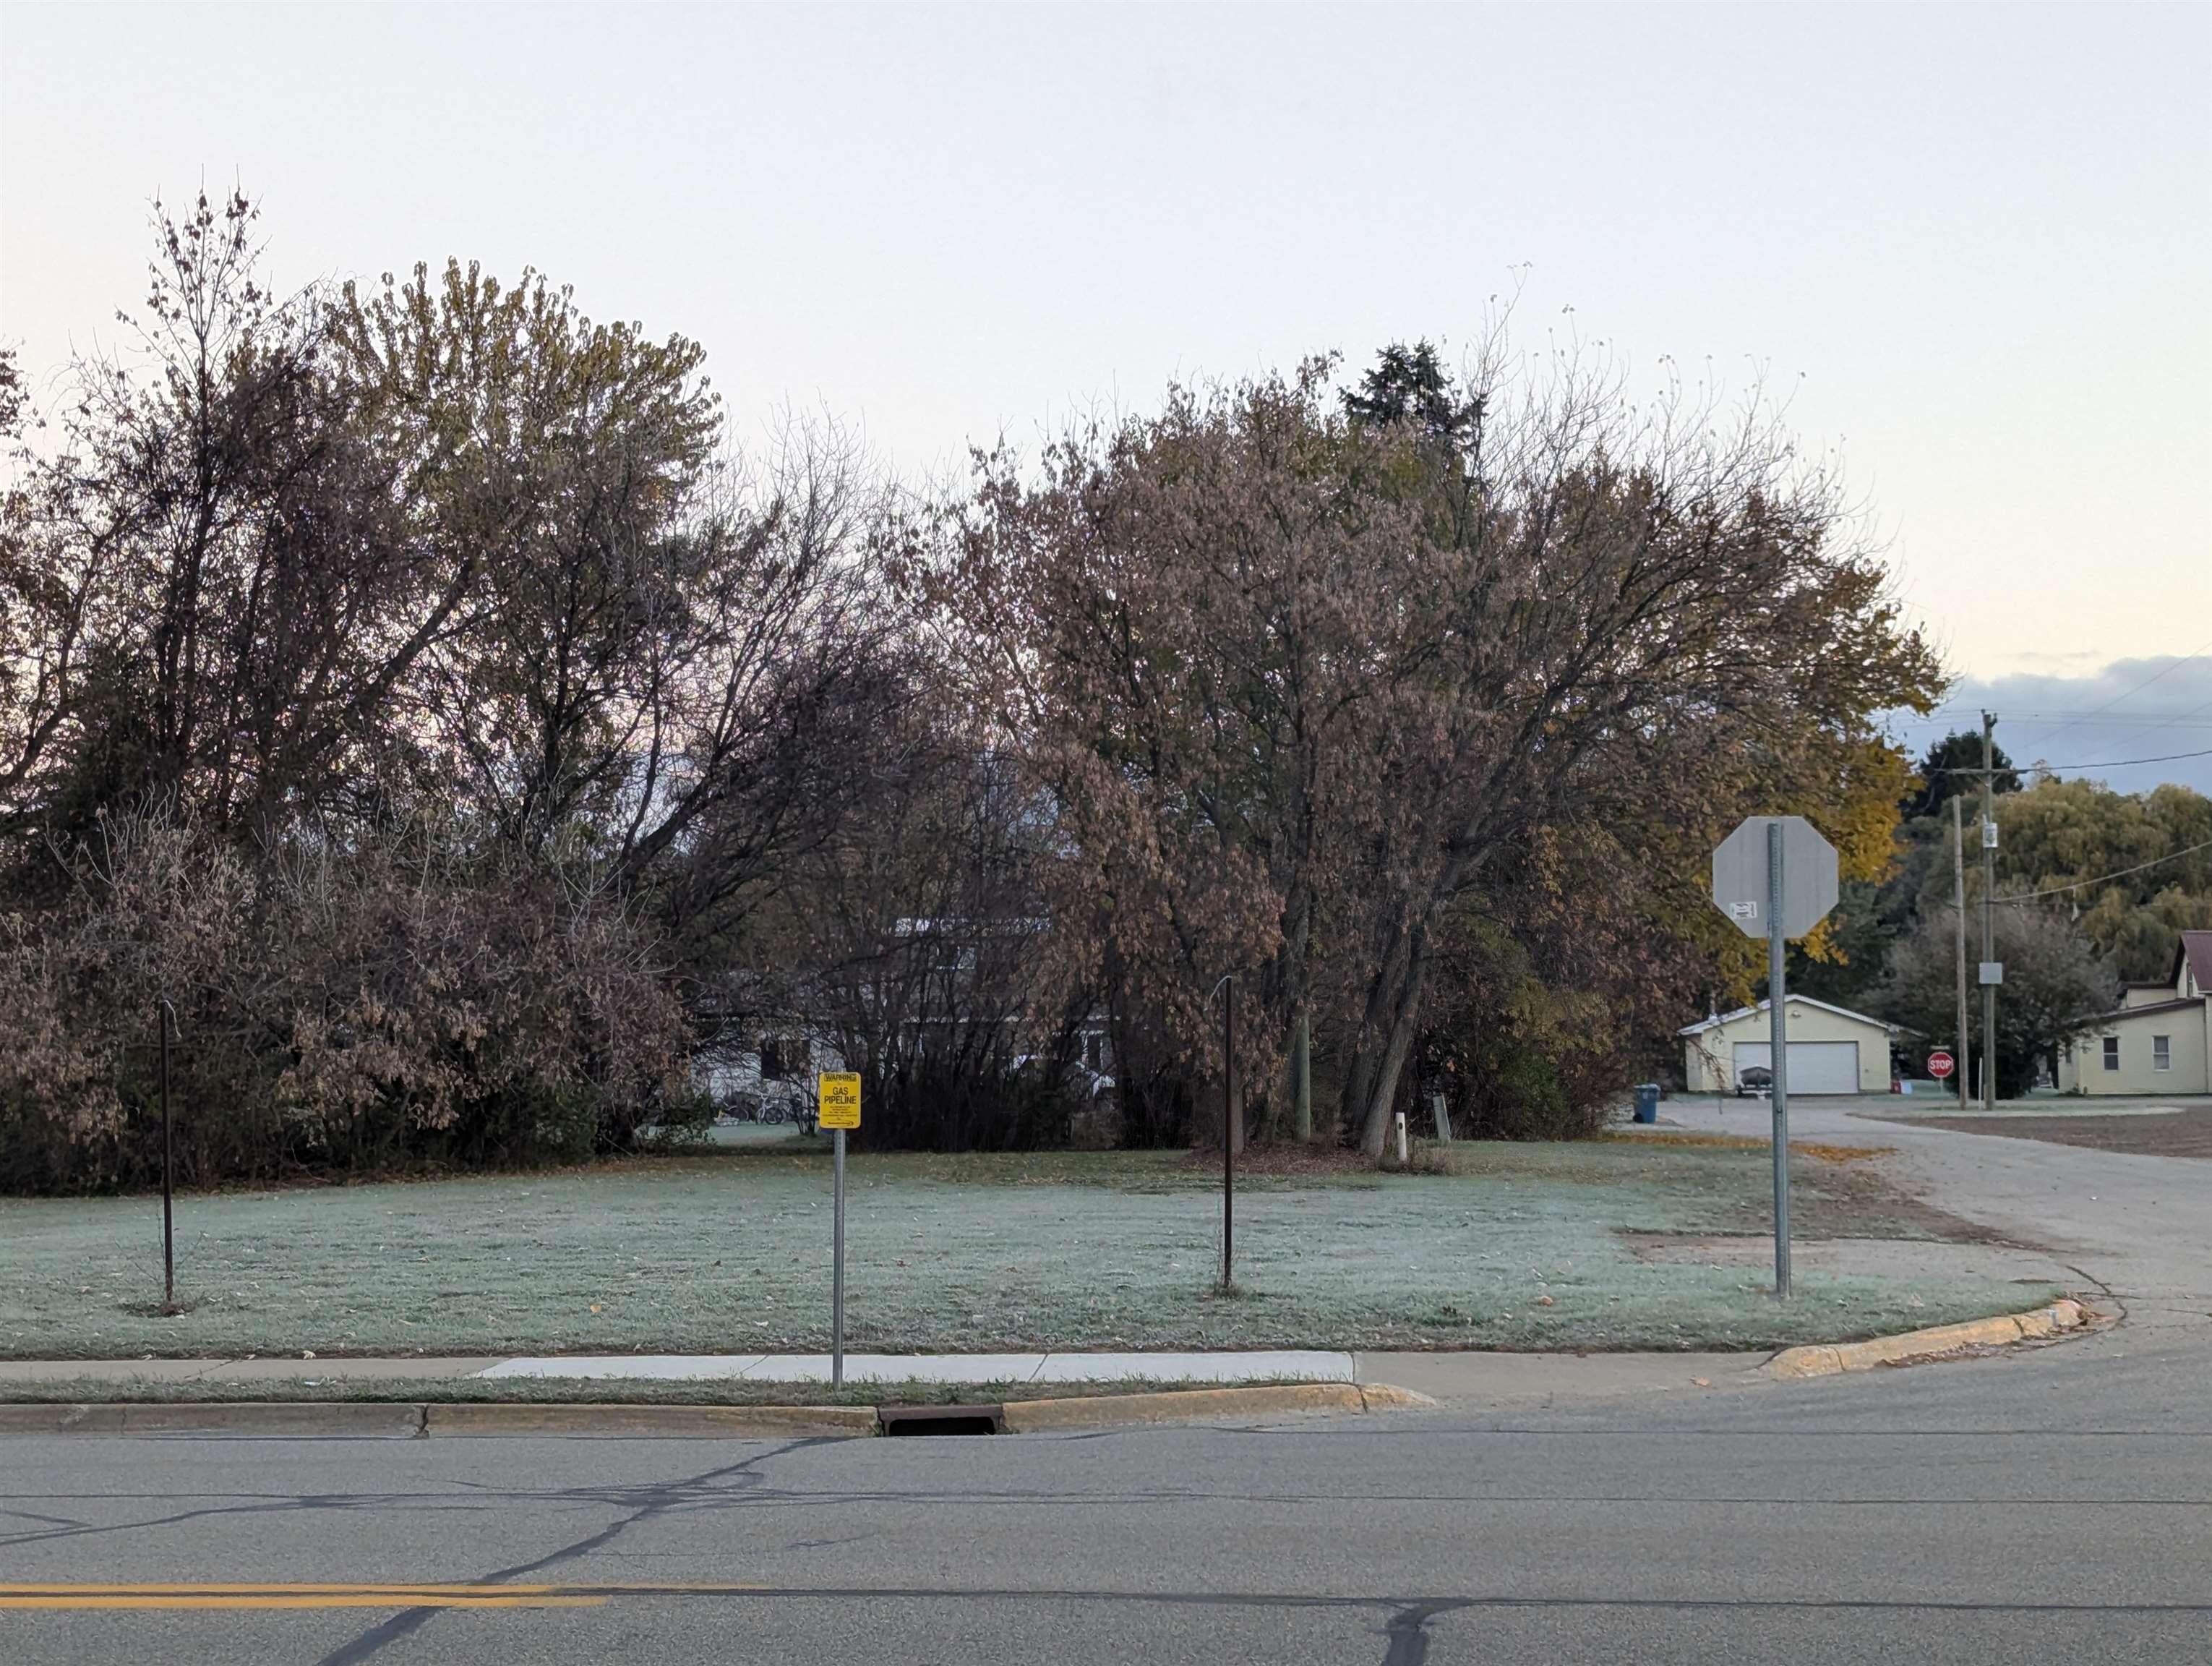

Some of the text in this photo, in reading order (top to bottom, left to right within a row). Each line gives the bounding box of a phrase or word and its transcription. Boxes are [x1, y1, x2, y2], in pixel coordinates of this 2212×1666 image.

[1929, 1059, 1952, 1069] STOP
[832, 1087, 849, 1095] GAS
[824, 1095, 857, 1104] PIPELINE
